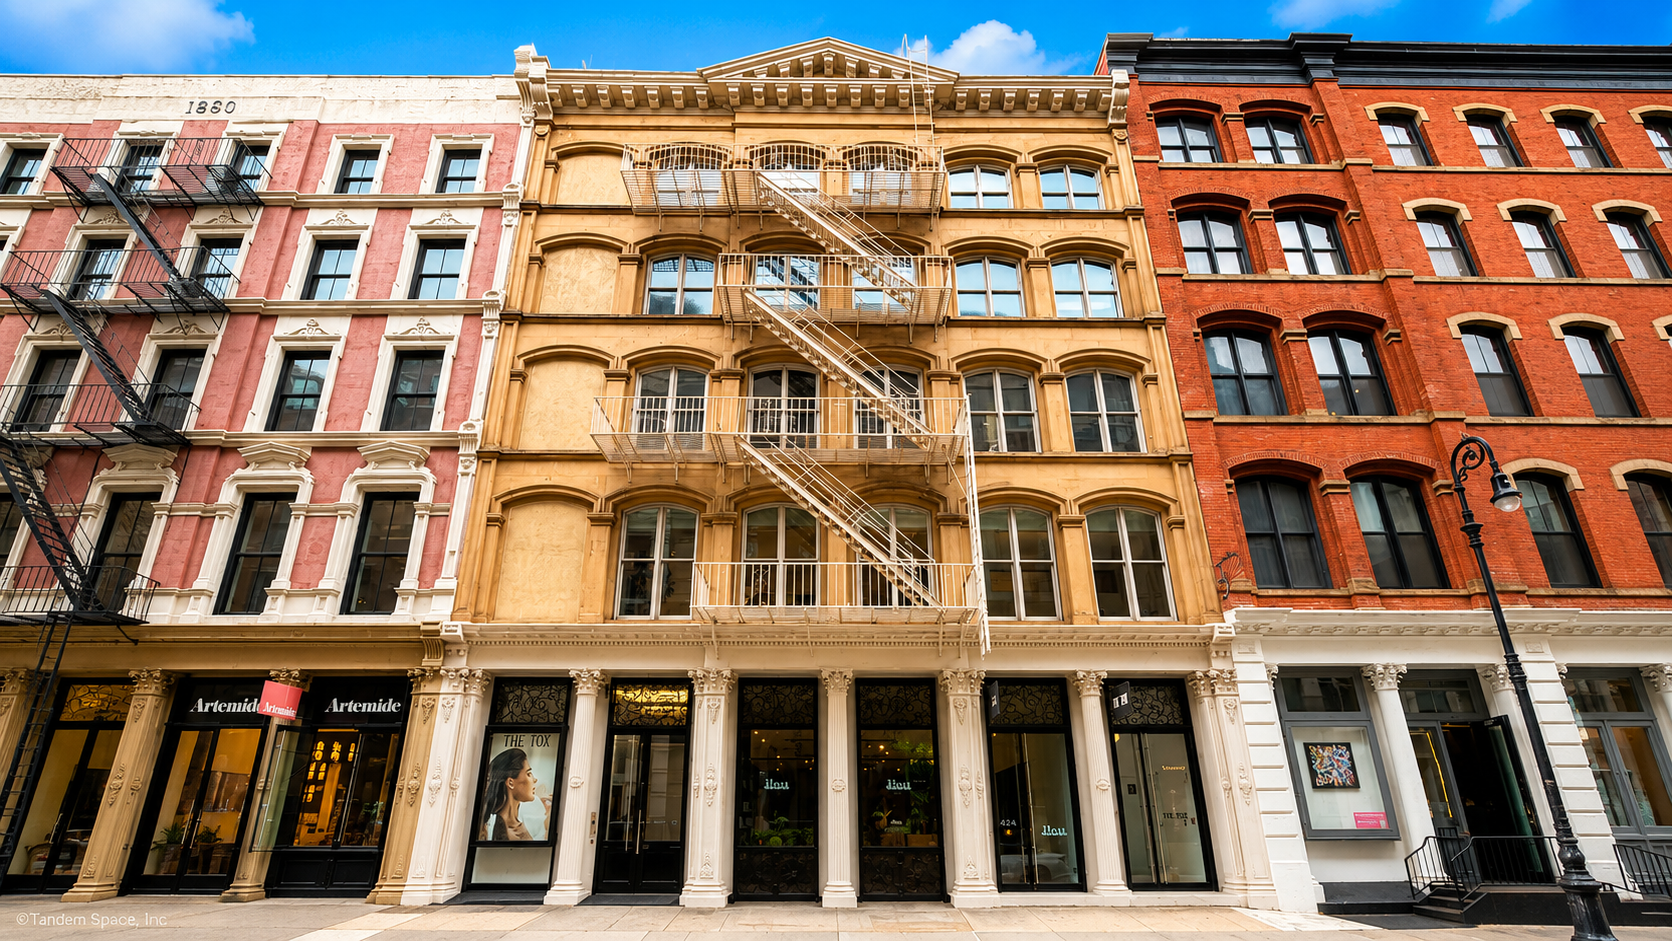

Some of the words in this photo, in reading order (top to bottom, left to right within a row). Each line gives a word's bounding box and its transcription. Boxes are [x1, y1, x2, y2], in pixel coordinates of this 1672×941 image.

[185, 100, 236, 114] 1880
[324, 697, 401, 713] Artemide
[503, 734, 526, 748] THE
[530, 734, 552, 748] TOX
[1000, 819, 1017, 827] 424
